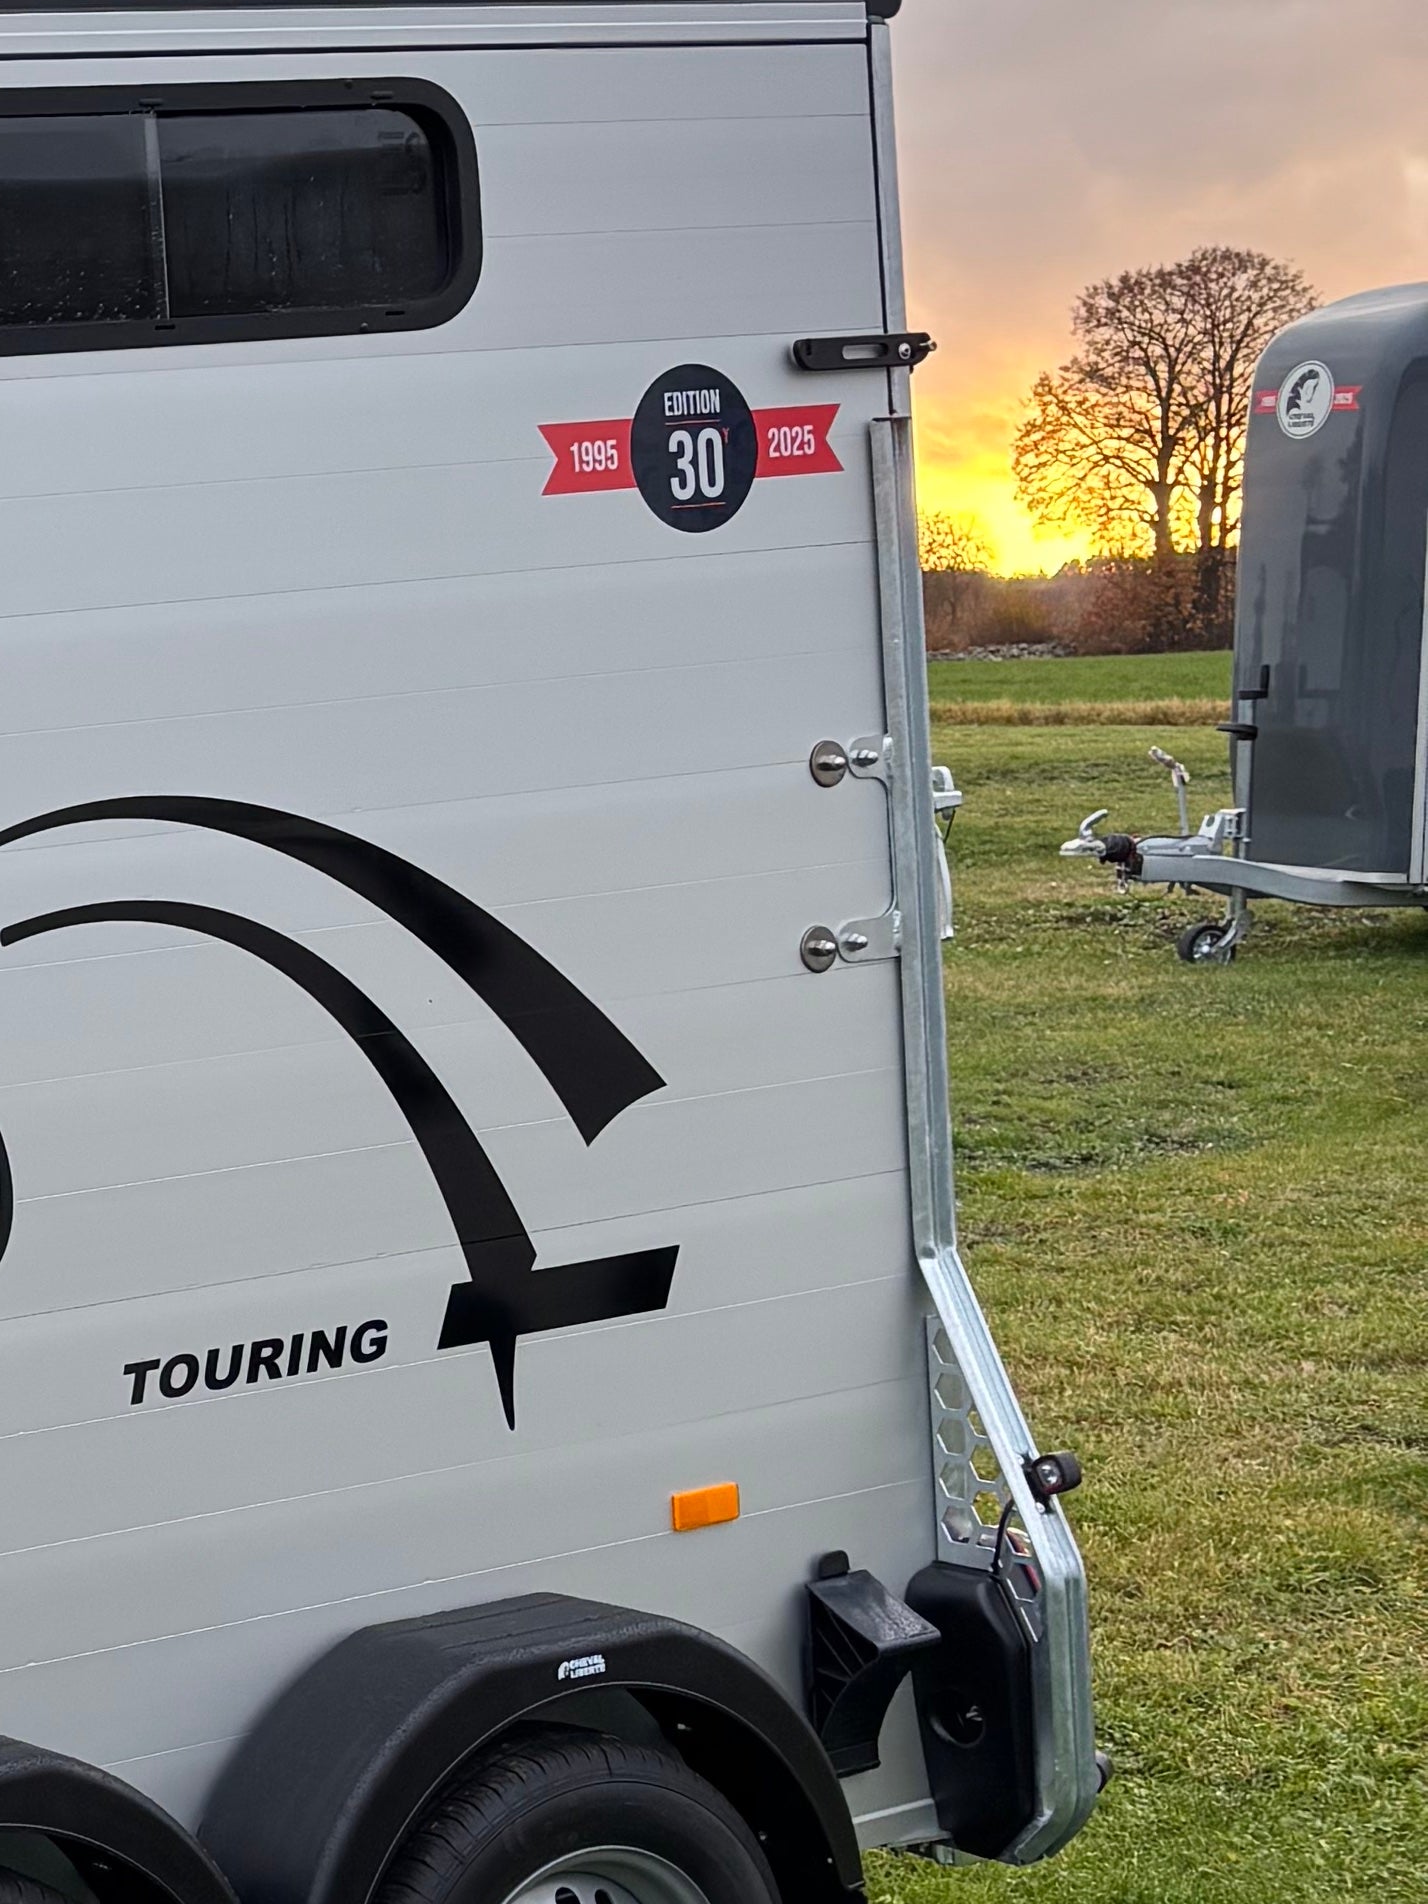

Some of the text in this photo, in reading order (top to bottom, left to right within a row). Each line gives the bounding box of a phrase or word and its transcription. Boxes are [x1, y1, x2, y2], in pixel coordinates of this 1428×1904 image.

[663, 389, 721, 416] EDITION
[570, 439, 618, 472] 1995
[768, 425, 815, 458] 2025
[123, 1319, 389, 1406] TOURING
